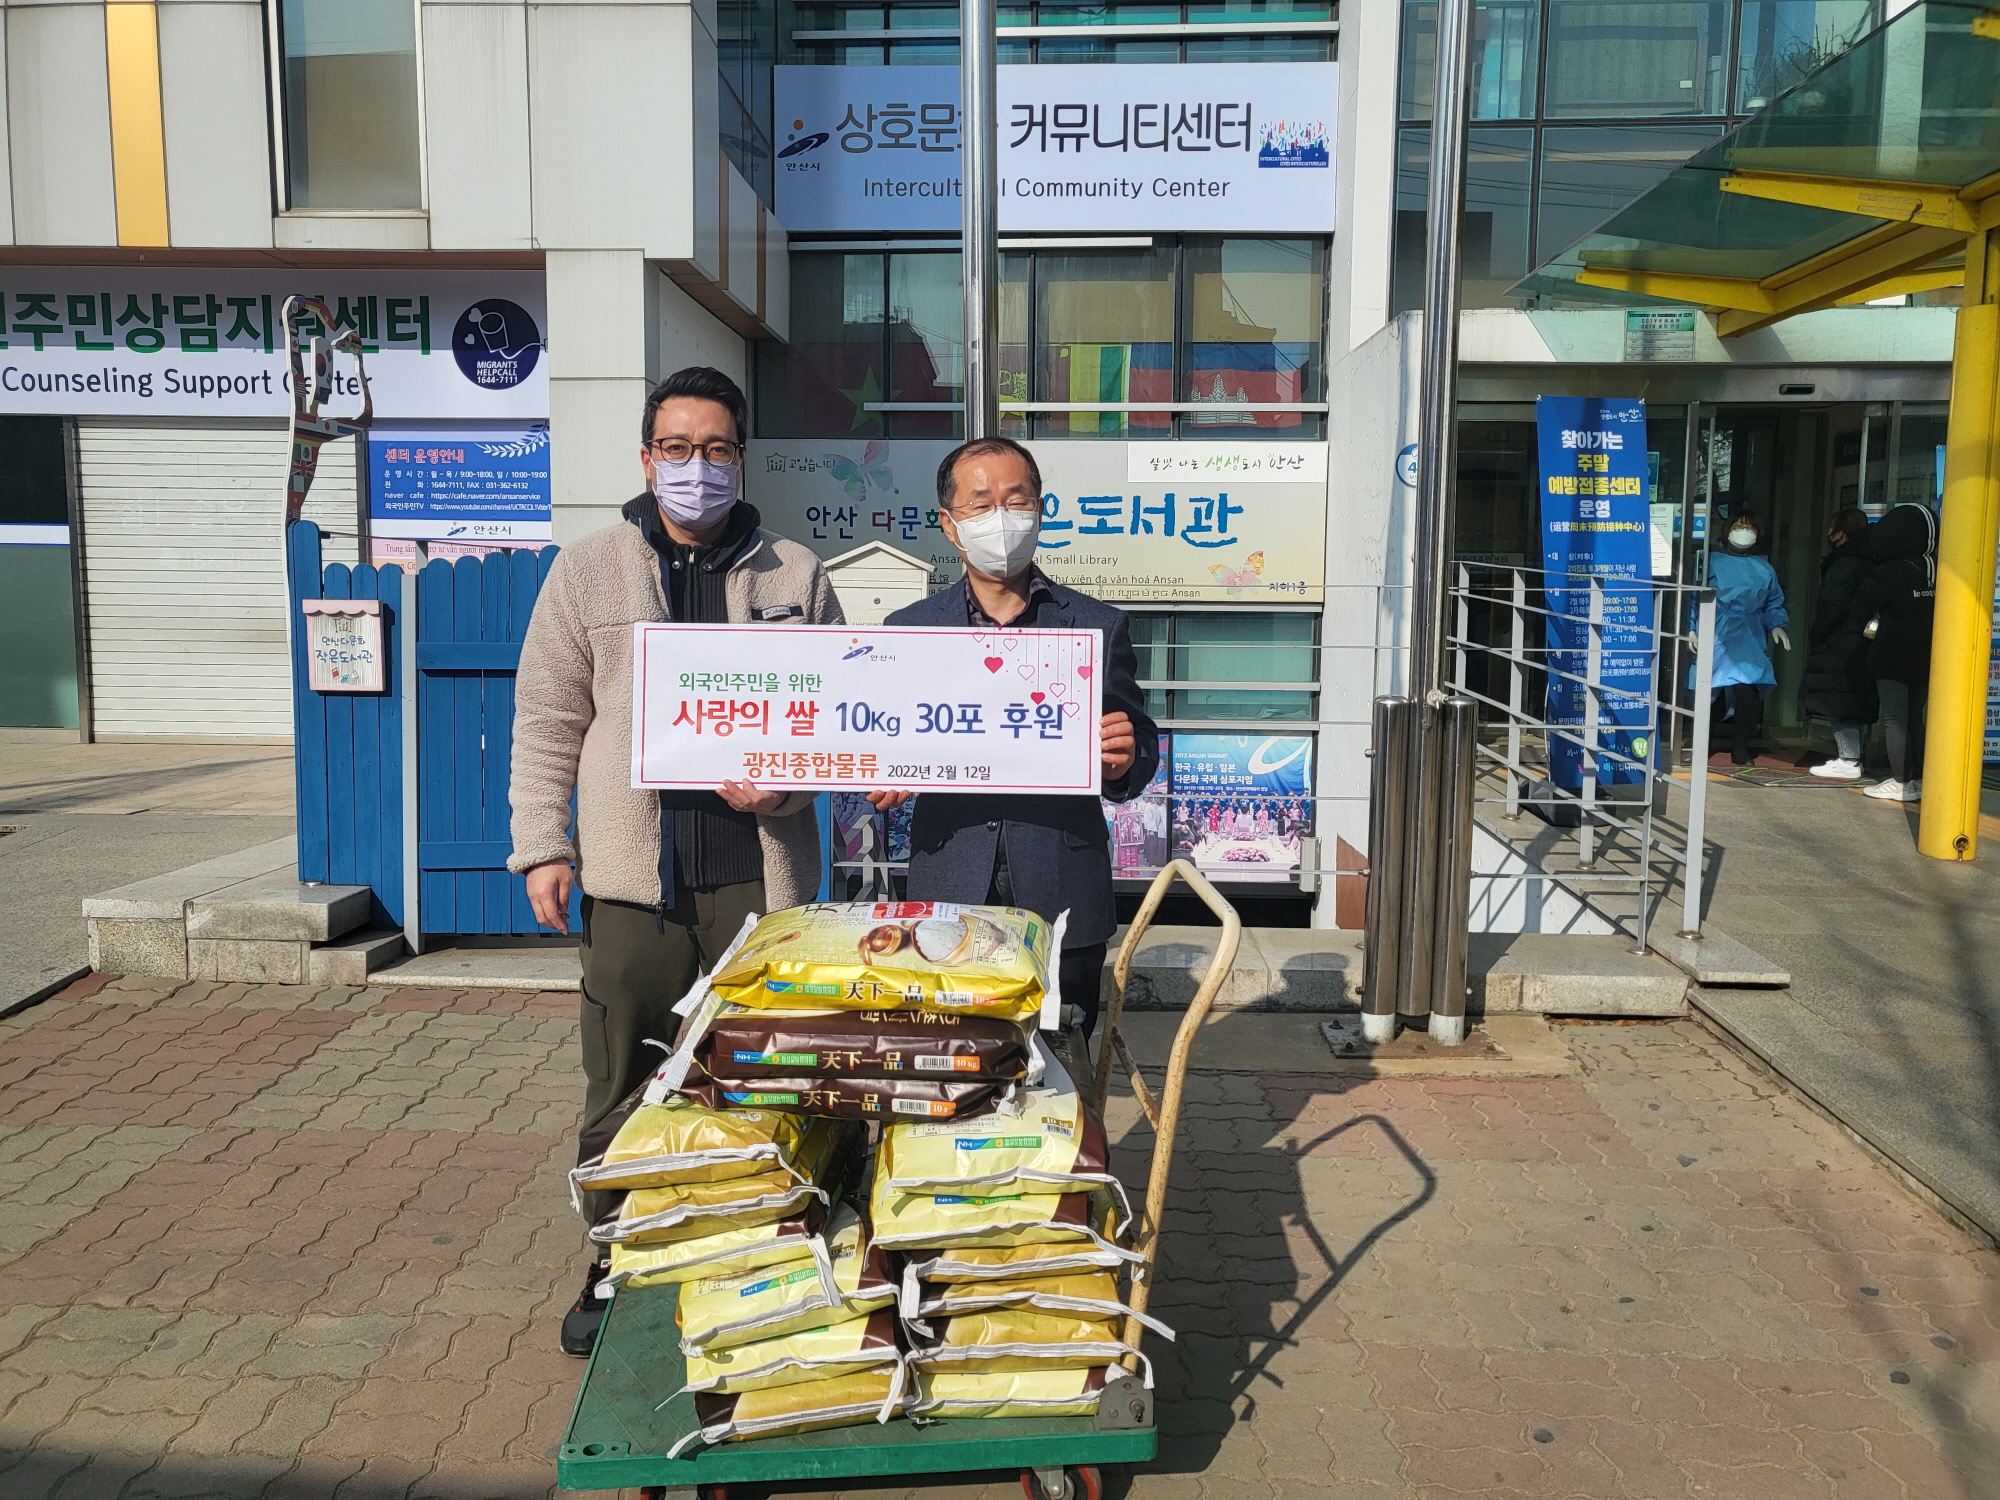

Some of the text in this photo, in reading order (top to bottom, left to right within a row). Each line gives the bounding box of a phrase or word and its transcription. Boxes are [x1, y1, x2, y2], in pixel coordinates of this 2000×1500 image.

[835, 102, 1252, 154] 상호문 커뮤니티센터
[786, 163, 820, 171] 안산시
[864, 177, 1231, 200] Intercultl Community Center
[476, 368, 518, 376] HELPCALL
[1, 366, 154, 398] Counseling
[164, 368, 273, 399] Support
[476, 376, 518, 384] 1644-7111
[1561, 429, 1623, 449] 찾아가는
[385, 448, 465, 464] 센터 운영안내
[1268, 454, 1305, 470] 안산
[1577, 454, 1610, 473] 주말
[1548, 476, 1641, 496] 예방접종센터
[1579, 499, 1611, 518] 운영
[806, 505, 858, 540] 안산
[1036, 491, 1245, 549] 은도서관
[473, 525, 512, 536] 안산시
[1046, 555, 1076, 565] Small
[1079, 554, 1119, 567] Library
[1110, 575, 1128, 584] văn
[1131, 574, 1150, 584] hoá
[1153, 575, 1184, 585] Ansan
[1172, 589, 1201, 598] Ansan
[1913, 590, 1921, 598] le
[321, 635, 366, 646] 안산다문화
[315, 649, 374, 664] 작은도서관
[870, 654, 896, 662] 안산시
[678, 672, 823, 694] 외국인주민을 위한
[672, 699, 1064, 740] 사랑의 쌀 10Kg 30포 후원
[742, 752, 991, 781] 광진종합물류 2022년 2월 12일
[1174, 763, 1237, 773] 한국 유럽 일본
[1174, 774, 1253, 785] 다문화 국제 심포지엄
[737, 1053, 751, 1061] NH
[821, 1050, 904, 1071] 天下一品
[967, 1061, 977, 1069] kg
[803, 1090, 882, 1112] 天下一品
[1058, 1120, 1070, 1128] kg
[957, 1140, 973, 1149] NH
[742, 1286, 758, 1295] NH
